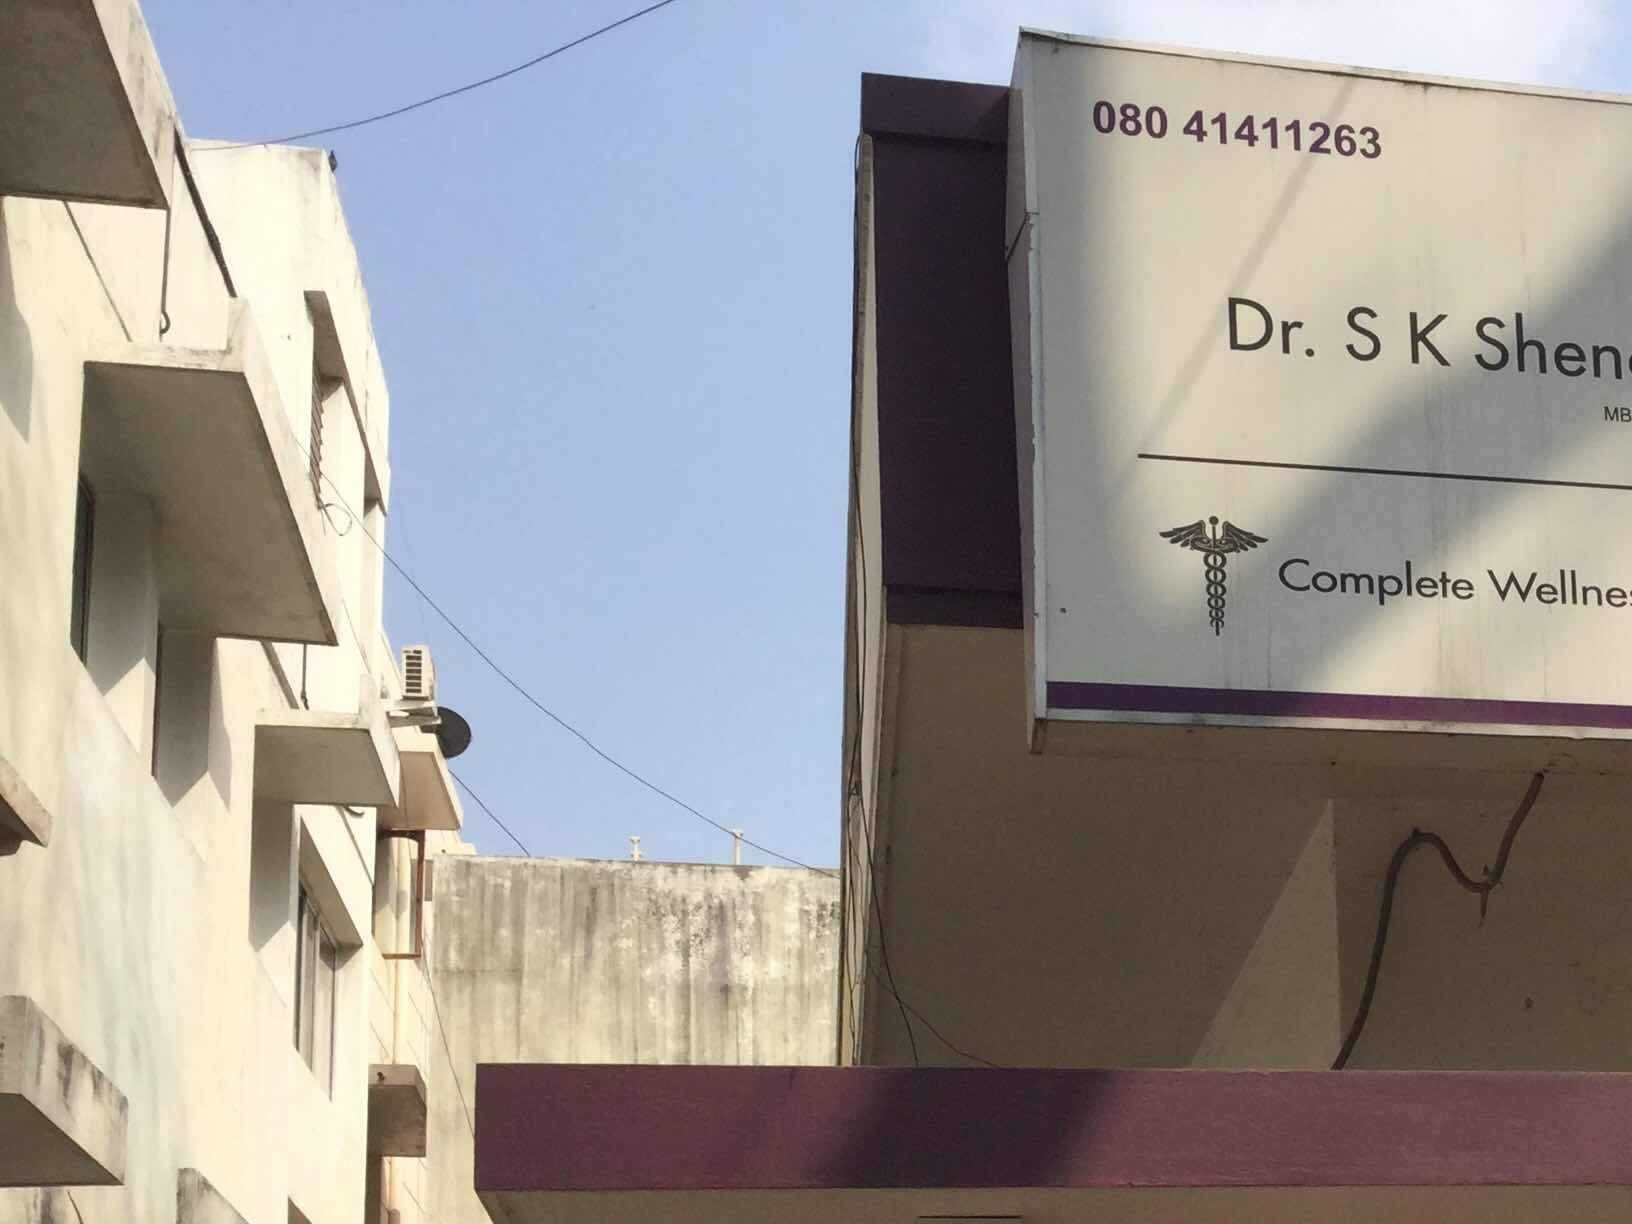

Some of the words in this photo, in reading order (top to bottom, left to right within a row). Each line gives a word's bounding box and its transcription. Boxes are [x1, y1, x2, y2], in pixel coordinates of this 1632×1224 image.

[1093, 100, 1168, 139] 080
[1183, 111, 1382, 159] 41411263
[1227, 297, 1315, 358] Dr.
[1346, 306, 1382, 362] S
[1409, 312, 1450, 367] K
[1278, 558, 1475, 605] Complete
